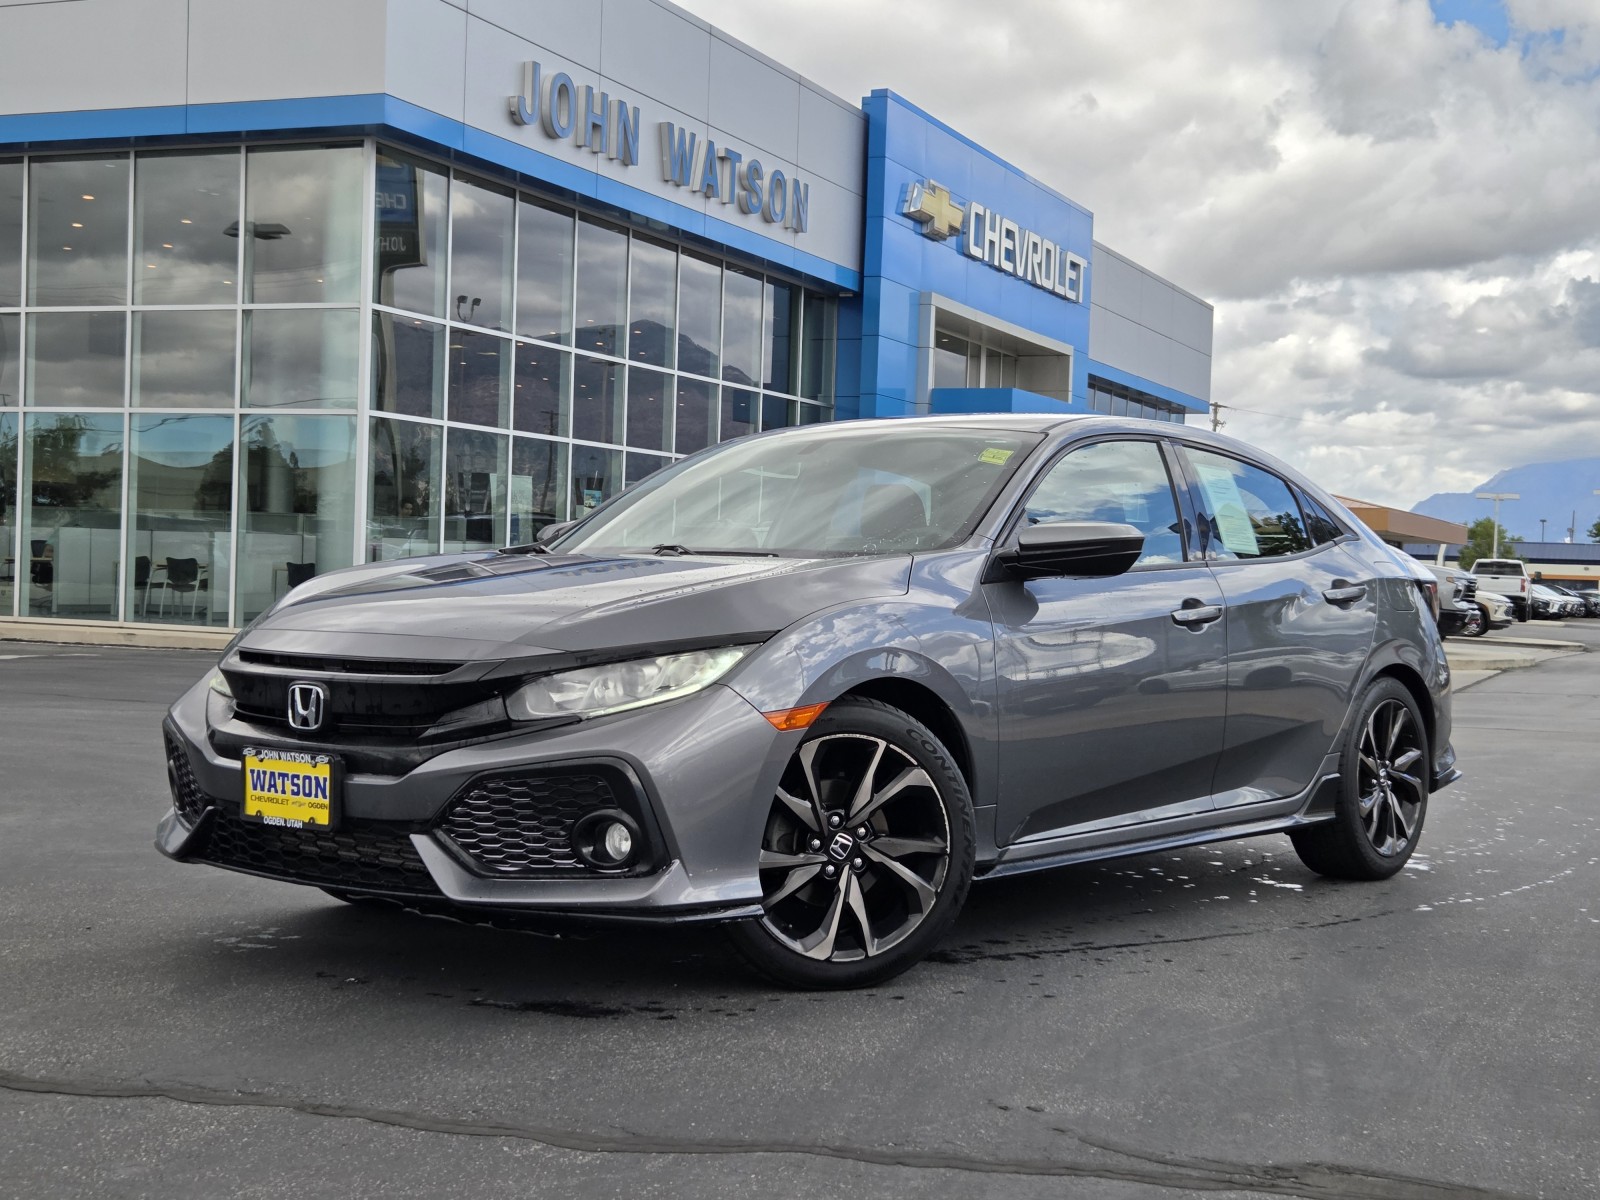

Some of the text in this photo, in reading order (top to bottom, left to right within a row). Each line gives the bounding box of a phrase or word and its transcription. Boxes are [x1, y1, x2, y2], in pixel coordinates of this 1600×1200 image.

[509, 60, 809, 233] JOHN WATSON
[963, 201, 1088, 303] CHEVROLET
[260, 749, 313, 764] JOHN WATSON
[250, 768, 328, 799] WATSON
[250, 794, 329, 811] CHEVROLET OGDEN
[905, 727, 974, 907] CONTINENTAL
[286, 818, 303, 829] UTAH
